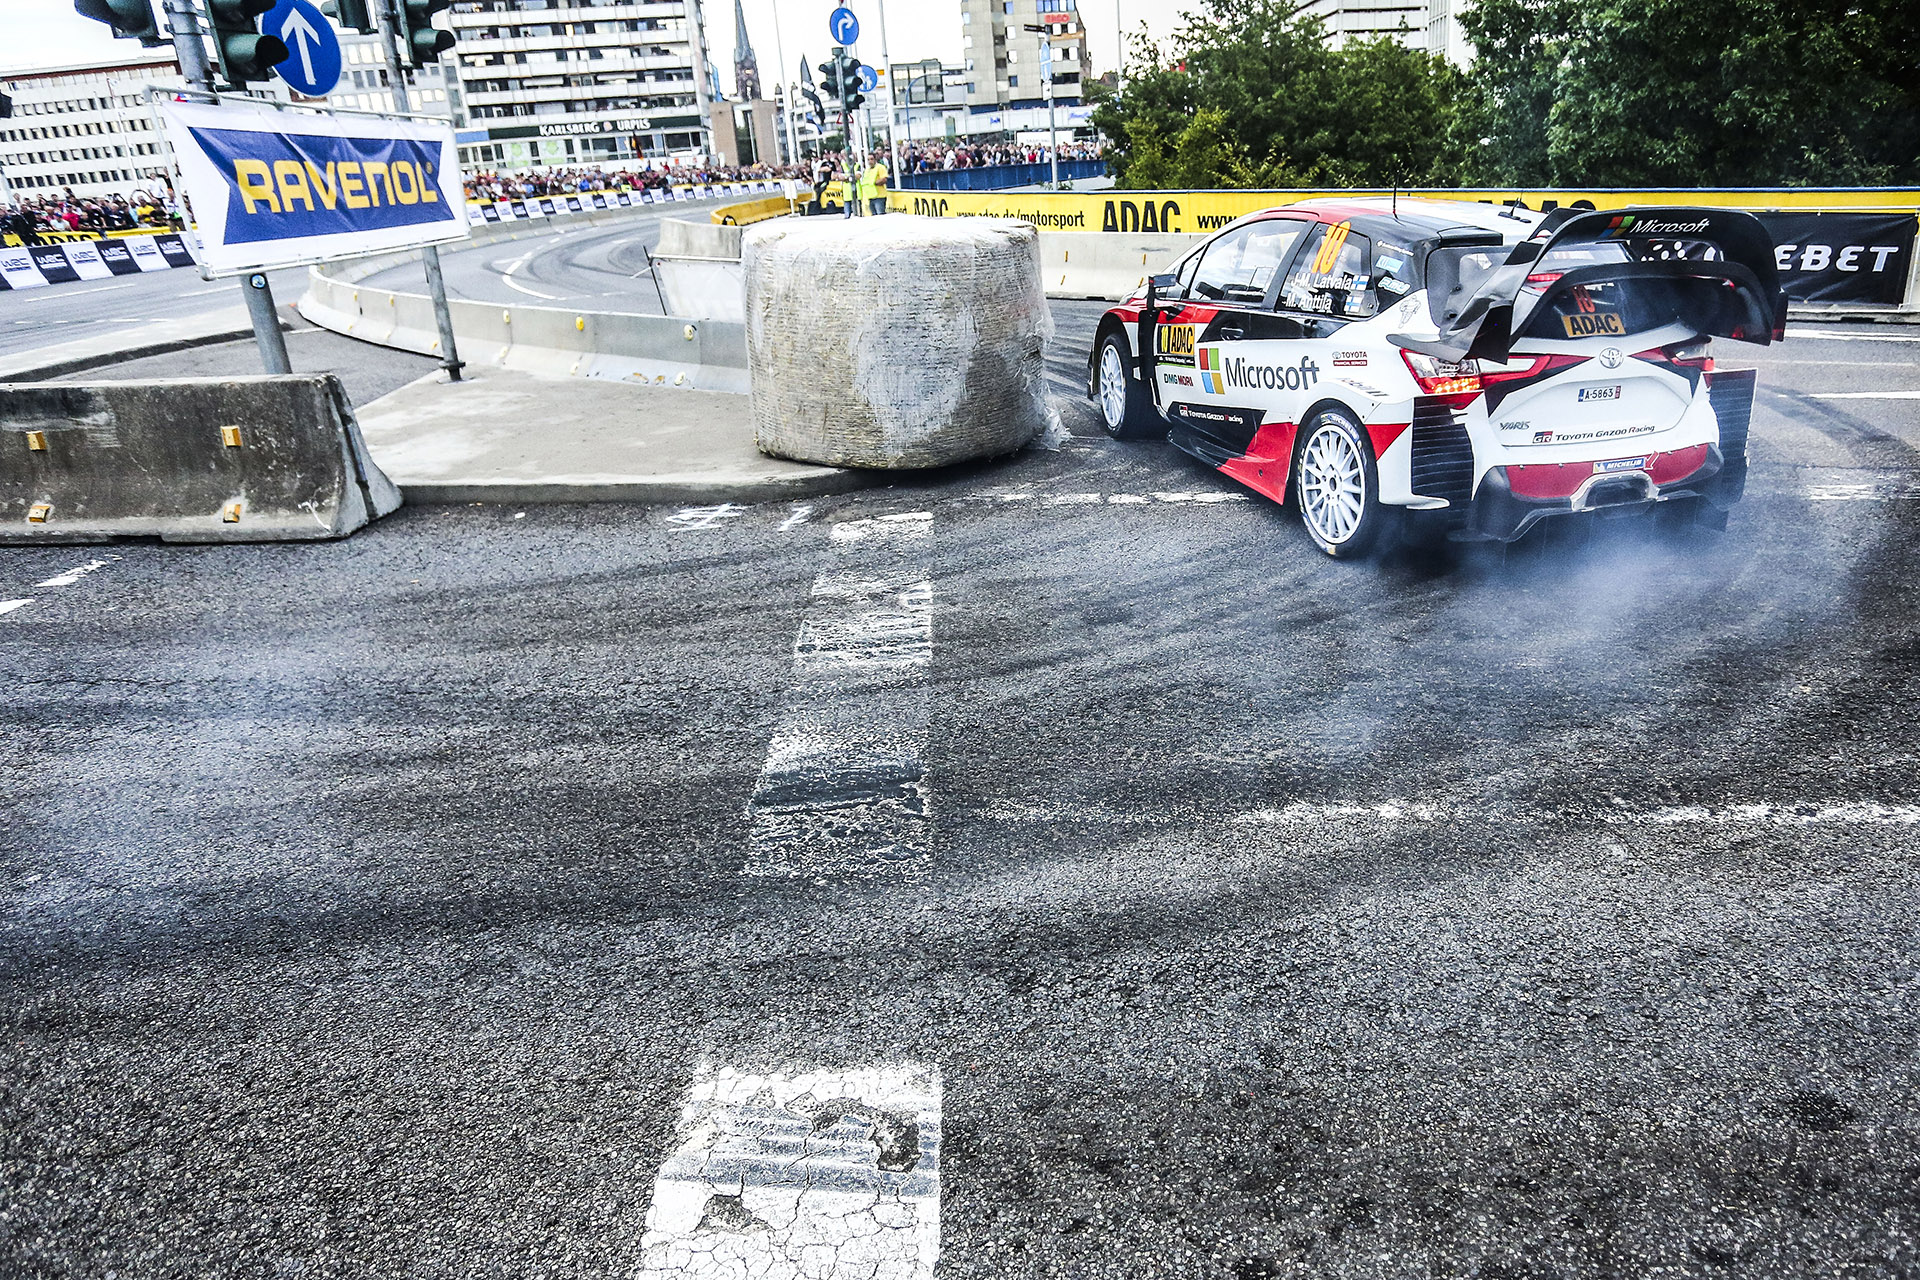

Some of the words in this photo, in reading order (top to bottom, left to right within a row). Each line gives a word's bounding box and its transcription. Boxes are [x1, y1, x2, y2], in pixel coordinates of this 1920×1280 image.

[540, 121, 600, 137] KARLSBERG
[616, 118, 651, 131] URPILS
[233, 159, 438, 214] RAVENOL
[1102, 200, 1181, 233] ADAC
[1629, 217, 1710, 234] Microsoft
[1311, 221, 1351, 274] 10
[1773, 244, 1900, 272] EBET
[1313, 274, 1353, 290] Latvala
[1298, 294, 1333, 311] Anttila
[1571, 284, 1596, 313] 10
[1570, 315, 1619, 336] ADAC
[1171, 326, 1194, 354] ADAC
[1341, 351, 1368, 359] TOYOTA
[1225, 355, 1320, 391] Microsoft
[1584, 388, 1614, 400] A-5863
[1500, 421, 1531, 431] YARIS
[1555, 432, 1593, 442] TOYOTA
[1595, 428, 1628, 438] GAZOO
[1628, 424, 1656, 434] Racing
[1606, 459, 1643, 470] MICHELIN
